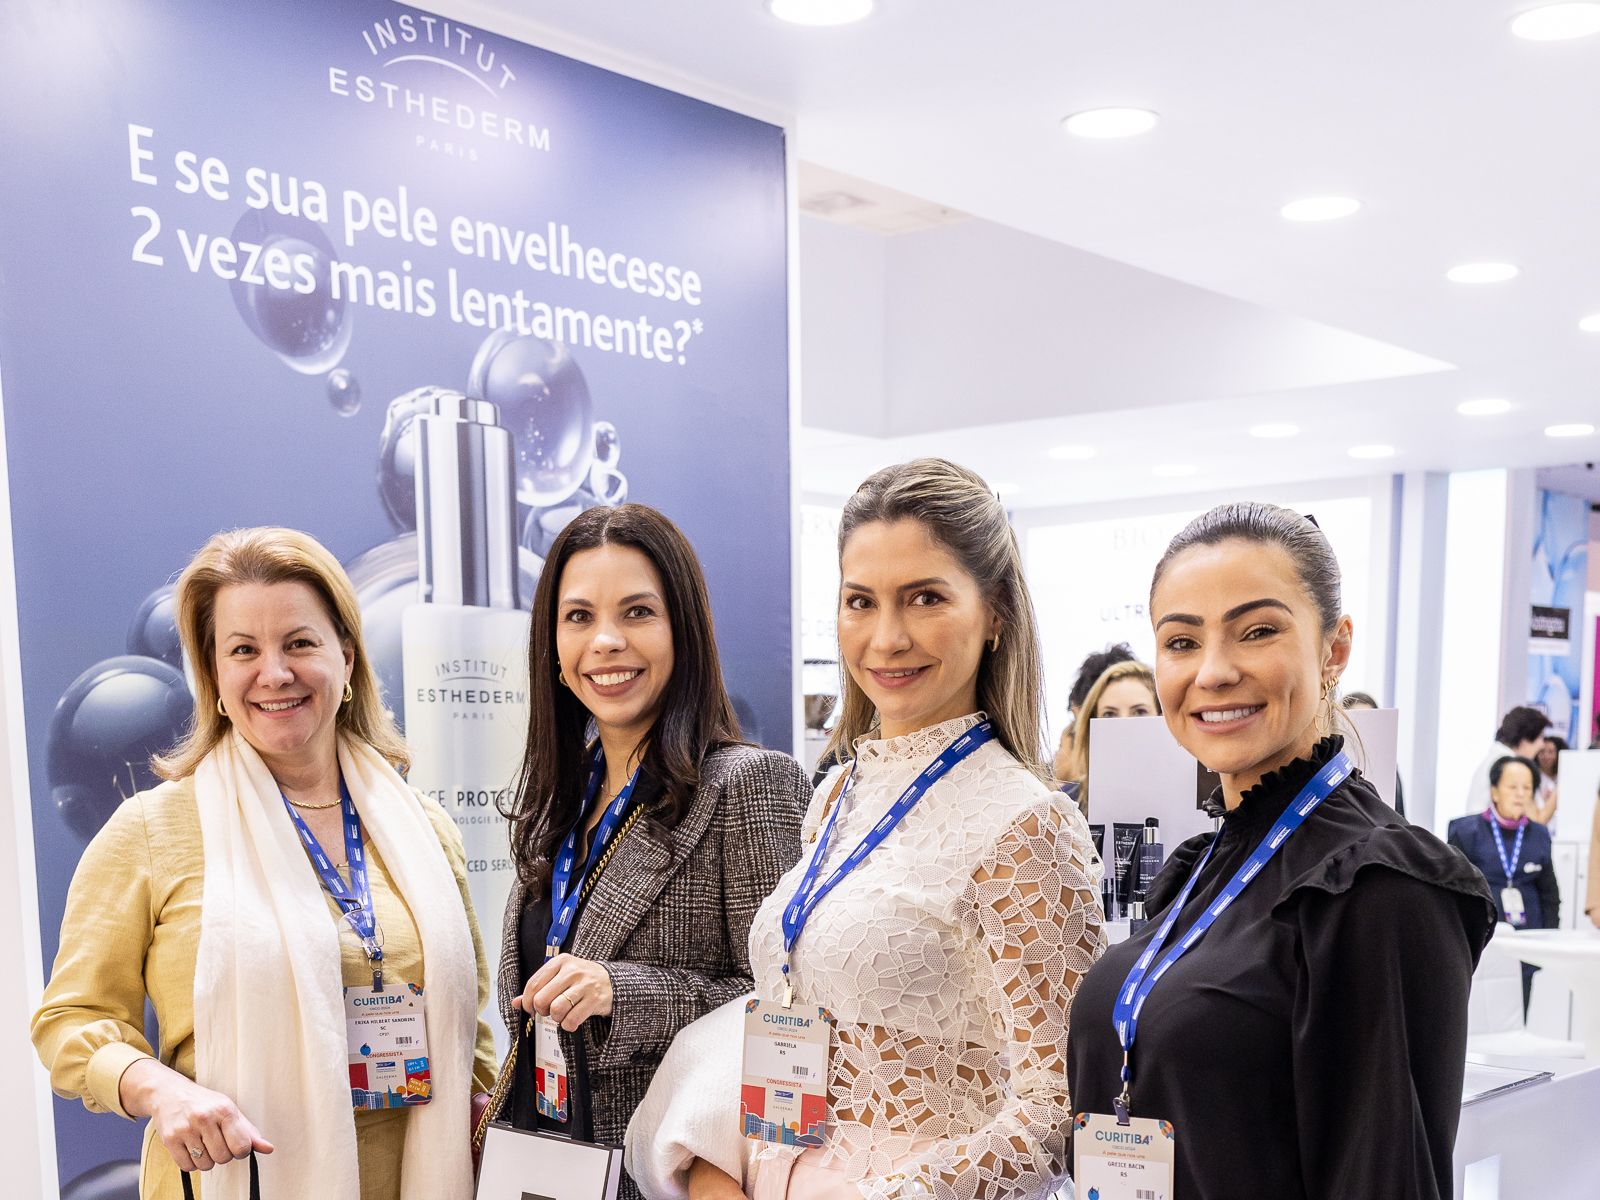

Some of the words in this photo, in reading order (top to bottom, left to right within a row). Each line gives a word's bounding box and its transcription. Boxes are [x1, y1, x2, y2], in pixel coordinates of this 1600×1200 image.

[362, 14, 516, 91] INSTITUT
[329, 67, 551, 152] ESTHEDERM
[416, 136, 479, 161] PARIS
[127, 123, 157, 186] E
[174, 148, 231, 201] se
[245, 165, 328, 223] sua
[344, 186, 437, 247] pele
[450, 216, 702, 305] envelhecesse
[130, 207, 164, 266] 2
[177, 228, 315, 294] vezes
[330, 257, 436, 317] mais
[417, 688, 525, 704] ESTHEDERM
[435, 659, 507, 679] INSTITUT
